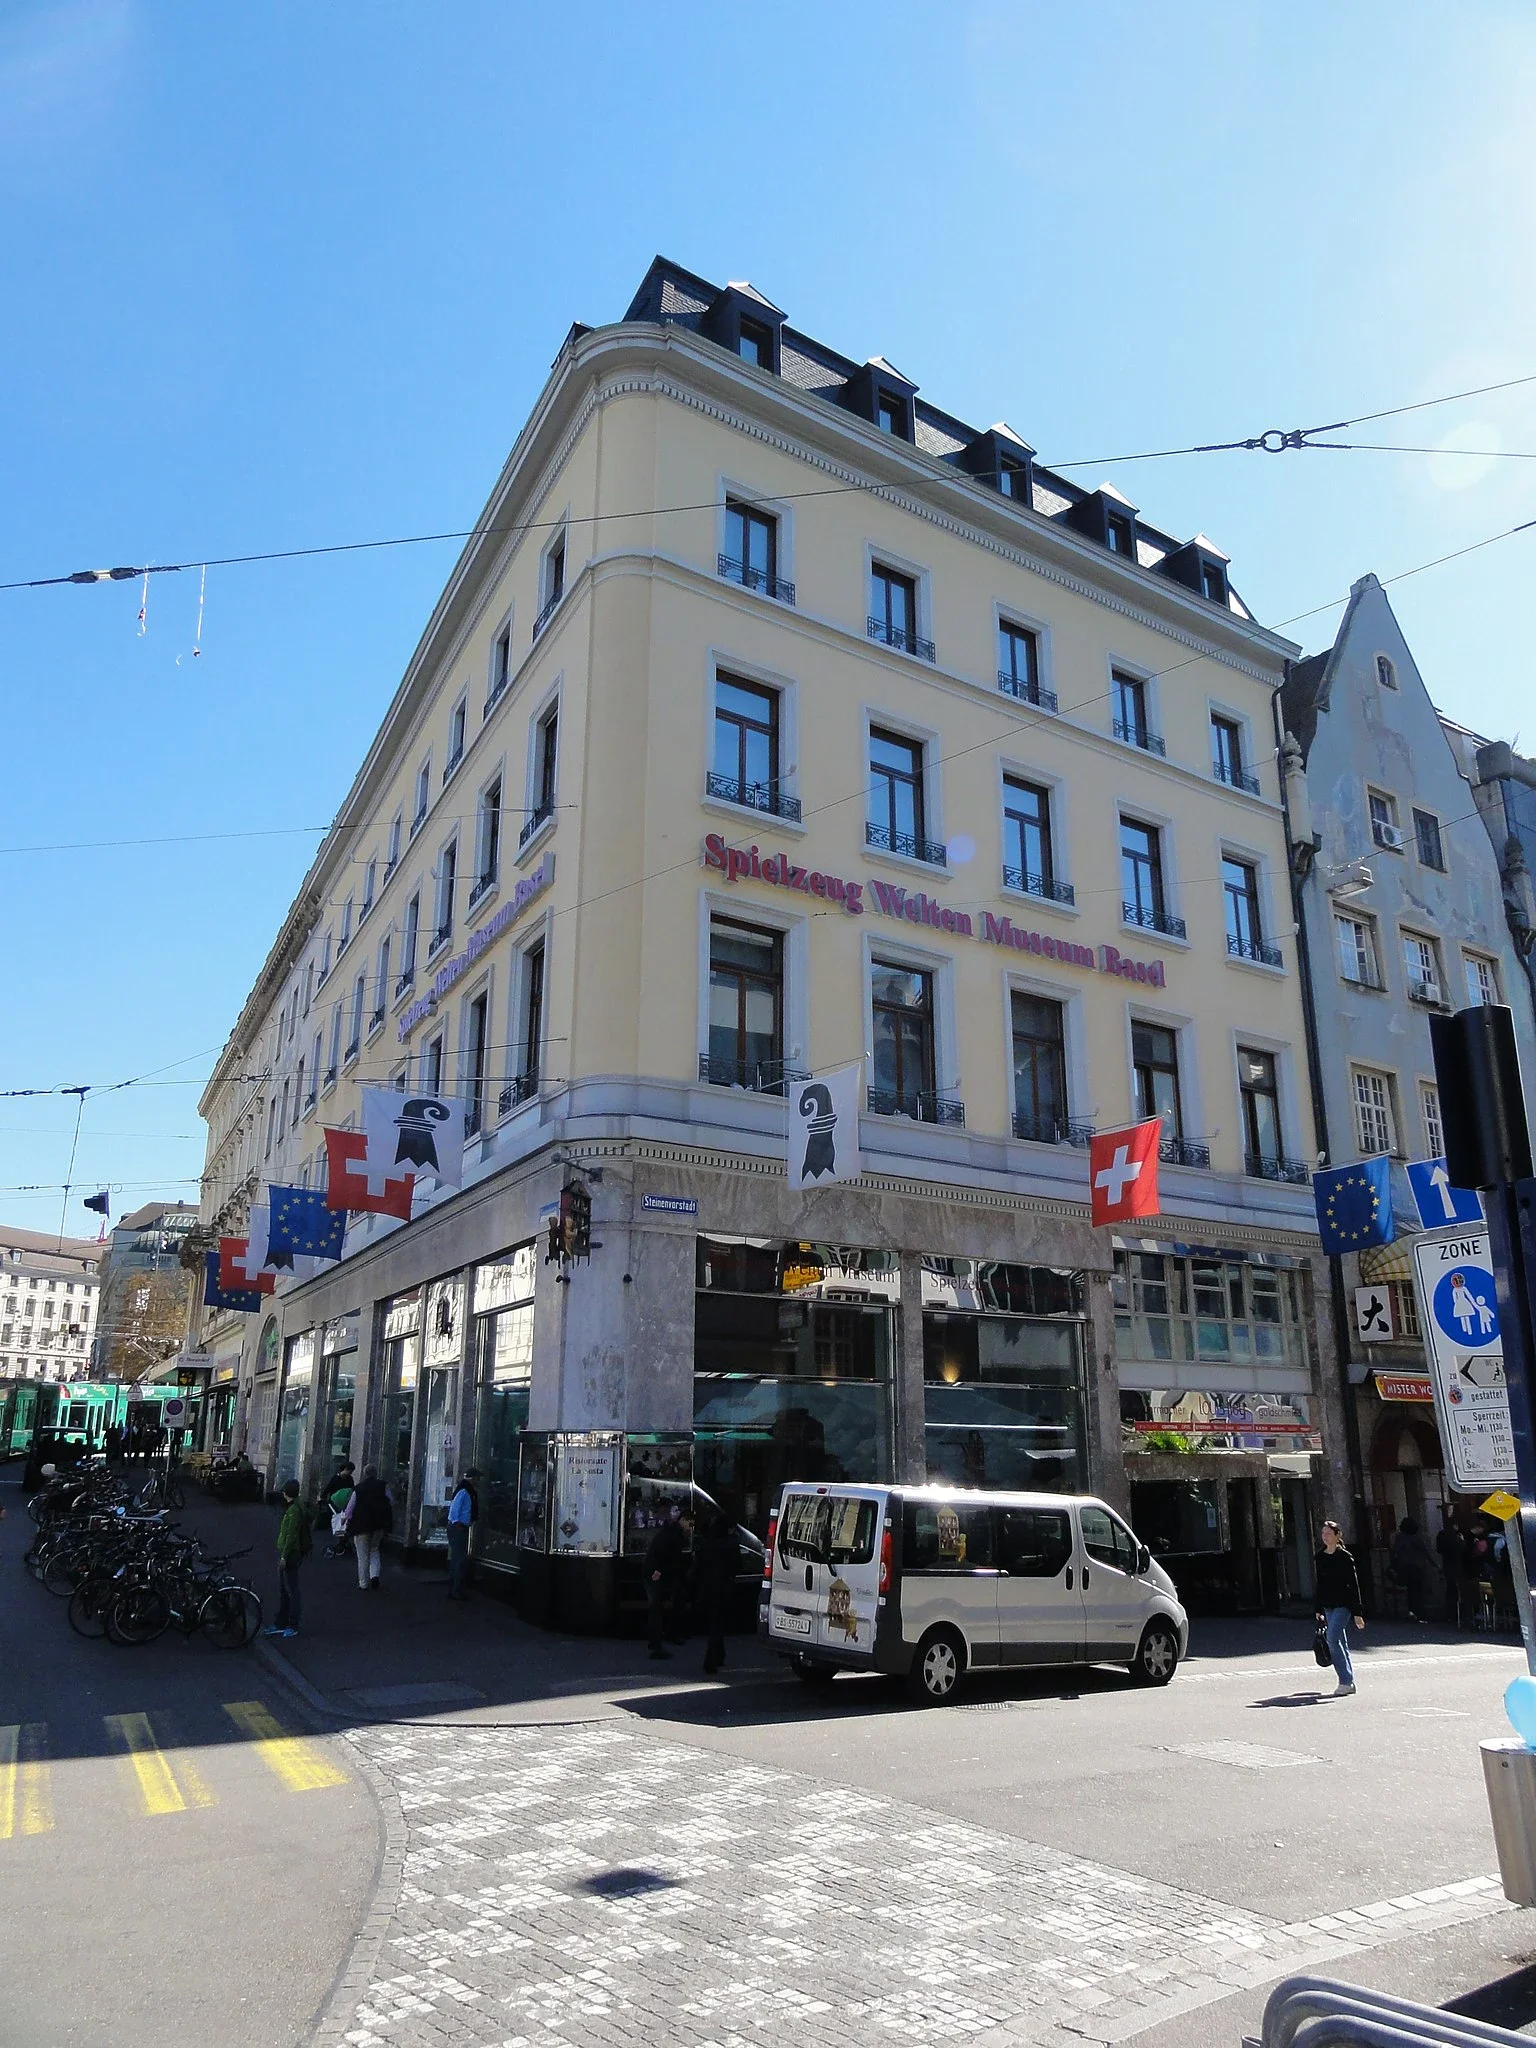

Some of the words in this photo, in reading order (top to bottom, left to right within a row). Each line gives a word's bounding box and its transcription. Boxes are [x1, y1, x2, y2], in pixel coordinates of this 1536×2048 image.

[703, 832, 864, 915] Spielzeug
[869, 878, 973, 937] Welten
[979, 909, 1095, 969] Museum
[1098, 943, 1167, 988] Basel
[644, 1195, 696, 1212] Steinenvorstadt
[1438, 1239, 1482, 1261] ZONE
[838, 1264, 896, 1283] Museum
[1361, 1294, 1390, 1333] 大
[1387, 1383, 1417, 1395] MISTER
[1470, 1389, 1504, 1402] gestattet
[1472, 1410, 1509, 1422] Sperrzeit:
